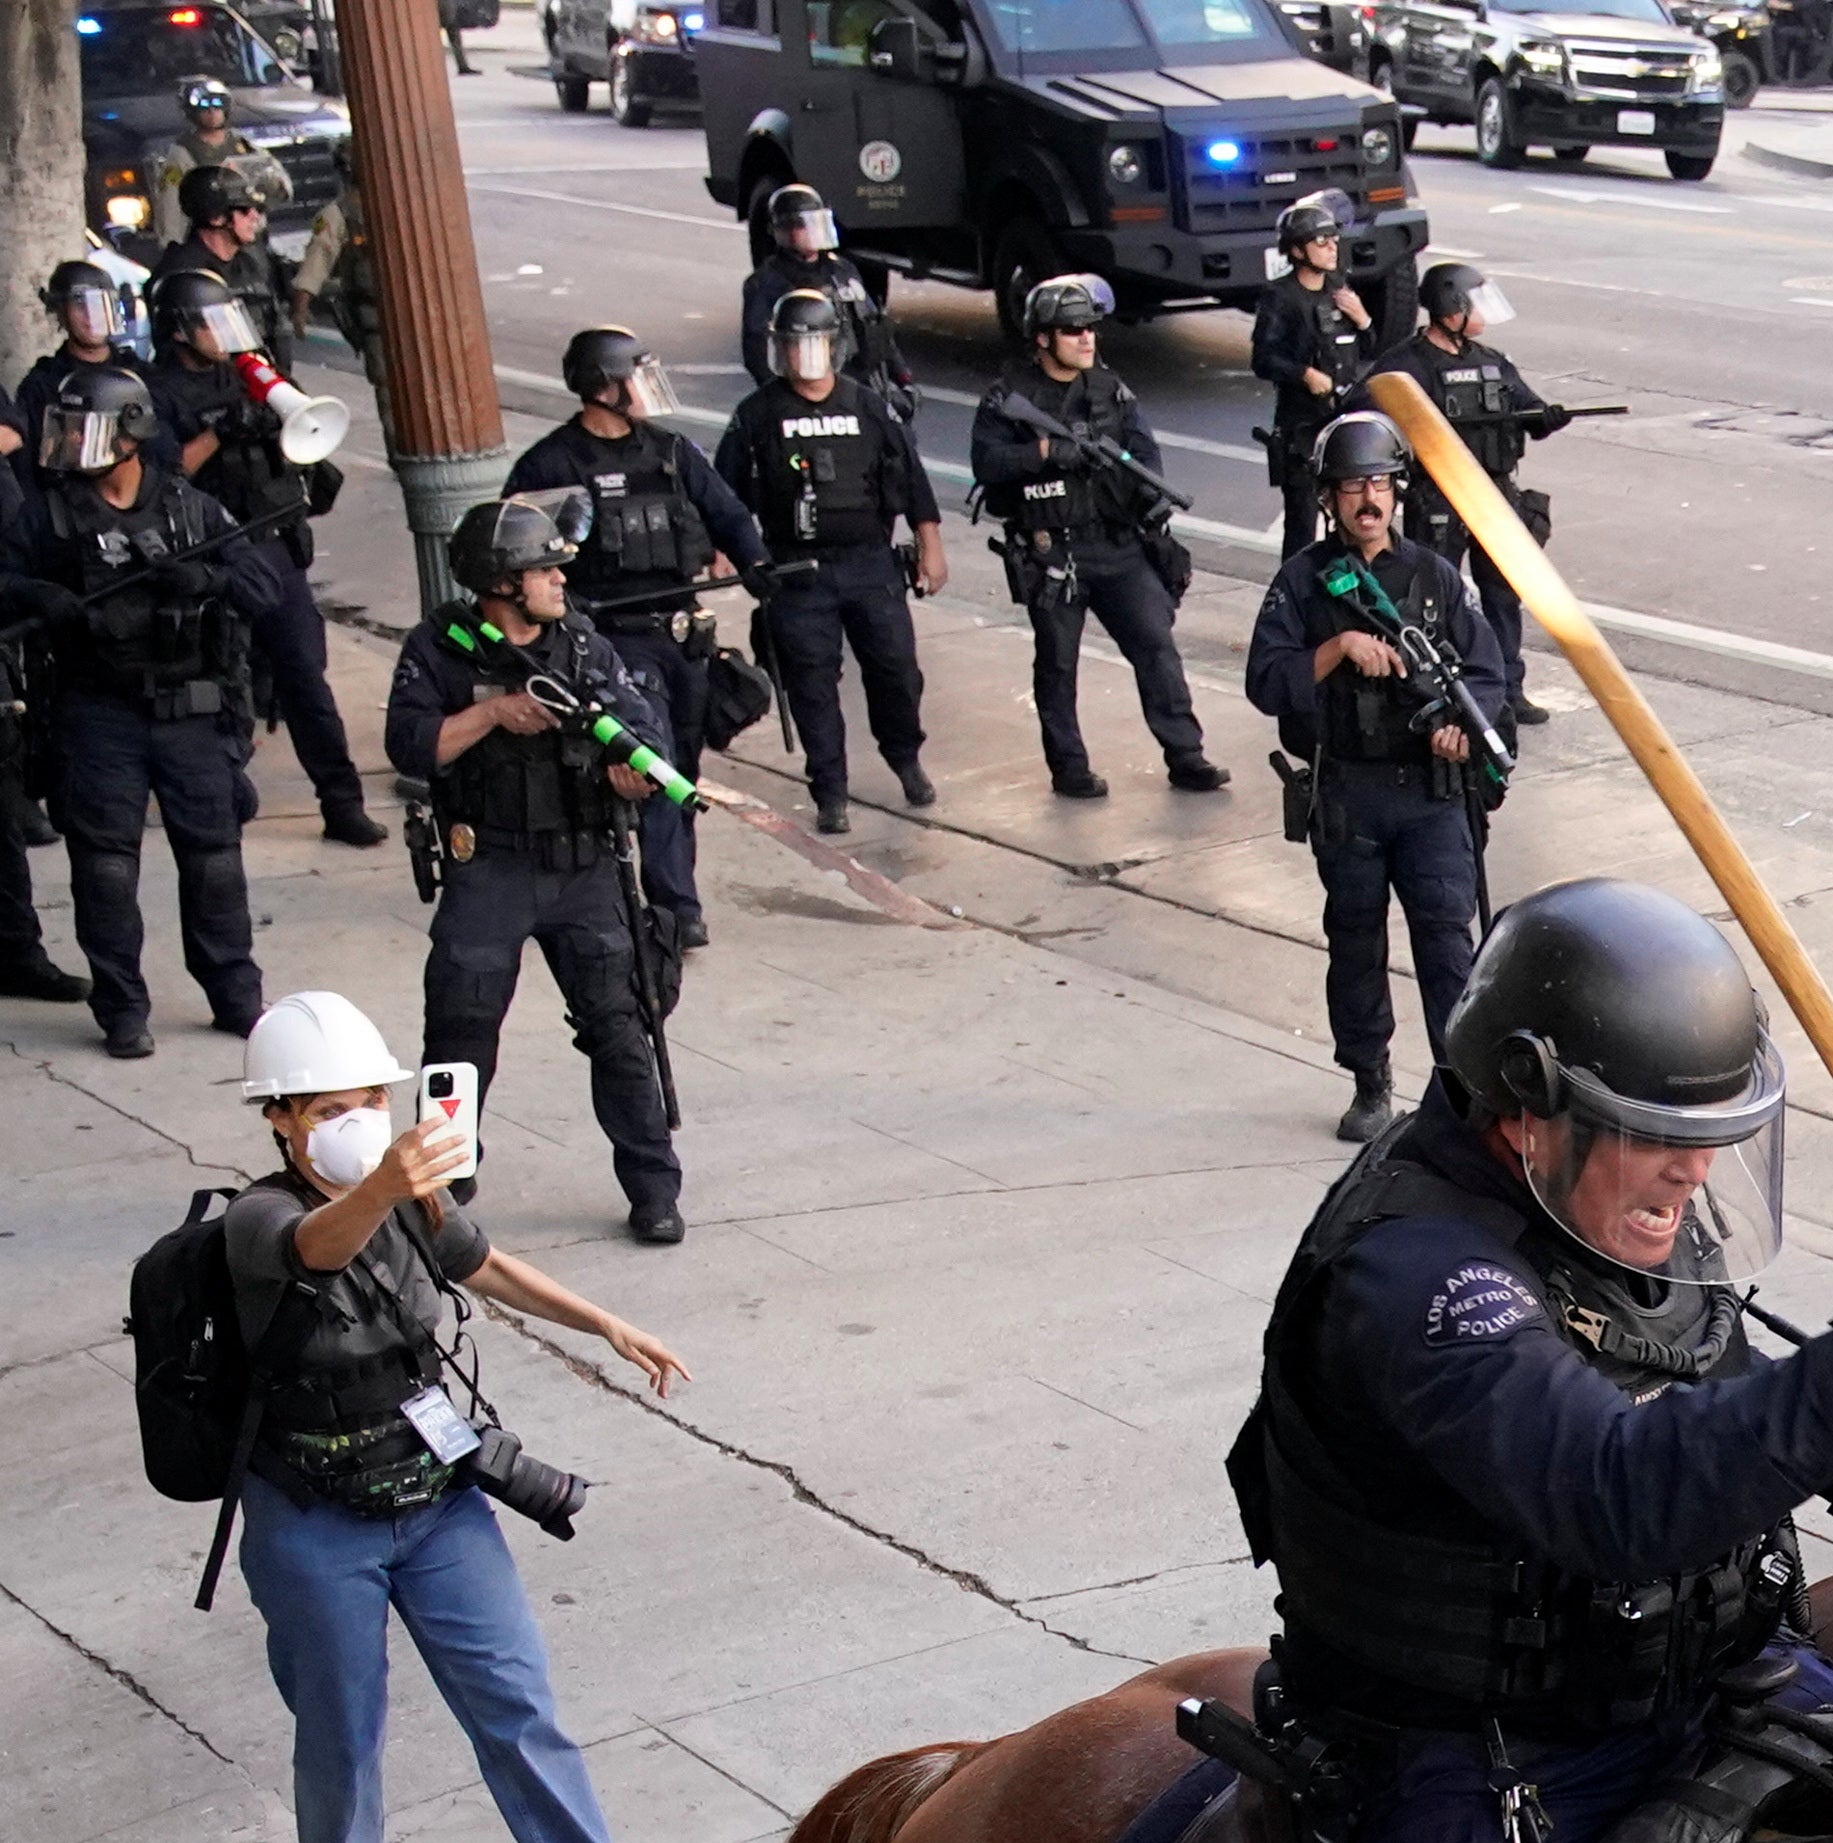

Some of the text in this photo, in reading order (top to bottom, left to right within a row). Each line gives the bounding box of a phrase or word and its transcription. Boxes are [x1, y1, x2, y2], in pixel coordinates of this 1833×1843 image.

[781, 415, 861, 438] POLICE
[1427, 1267, 1538, 1336] LOS ANGELES
[1449, 1289, 1512, 1318] METRO
[1457, 1306, 1525, 1337] POLICE
